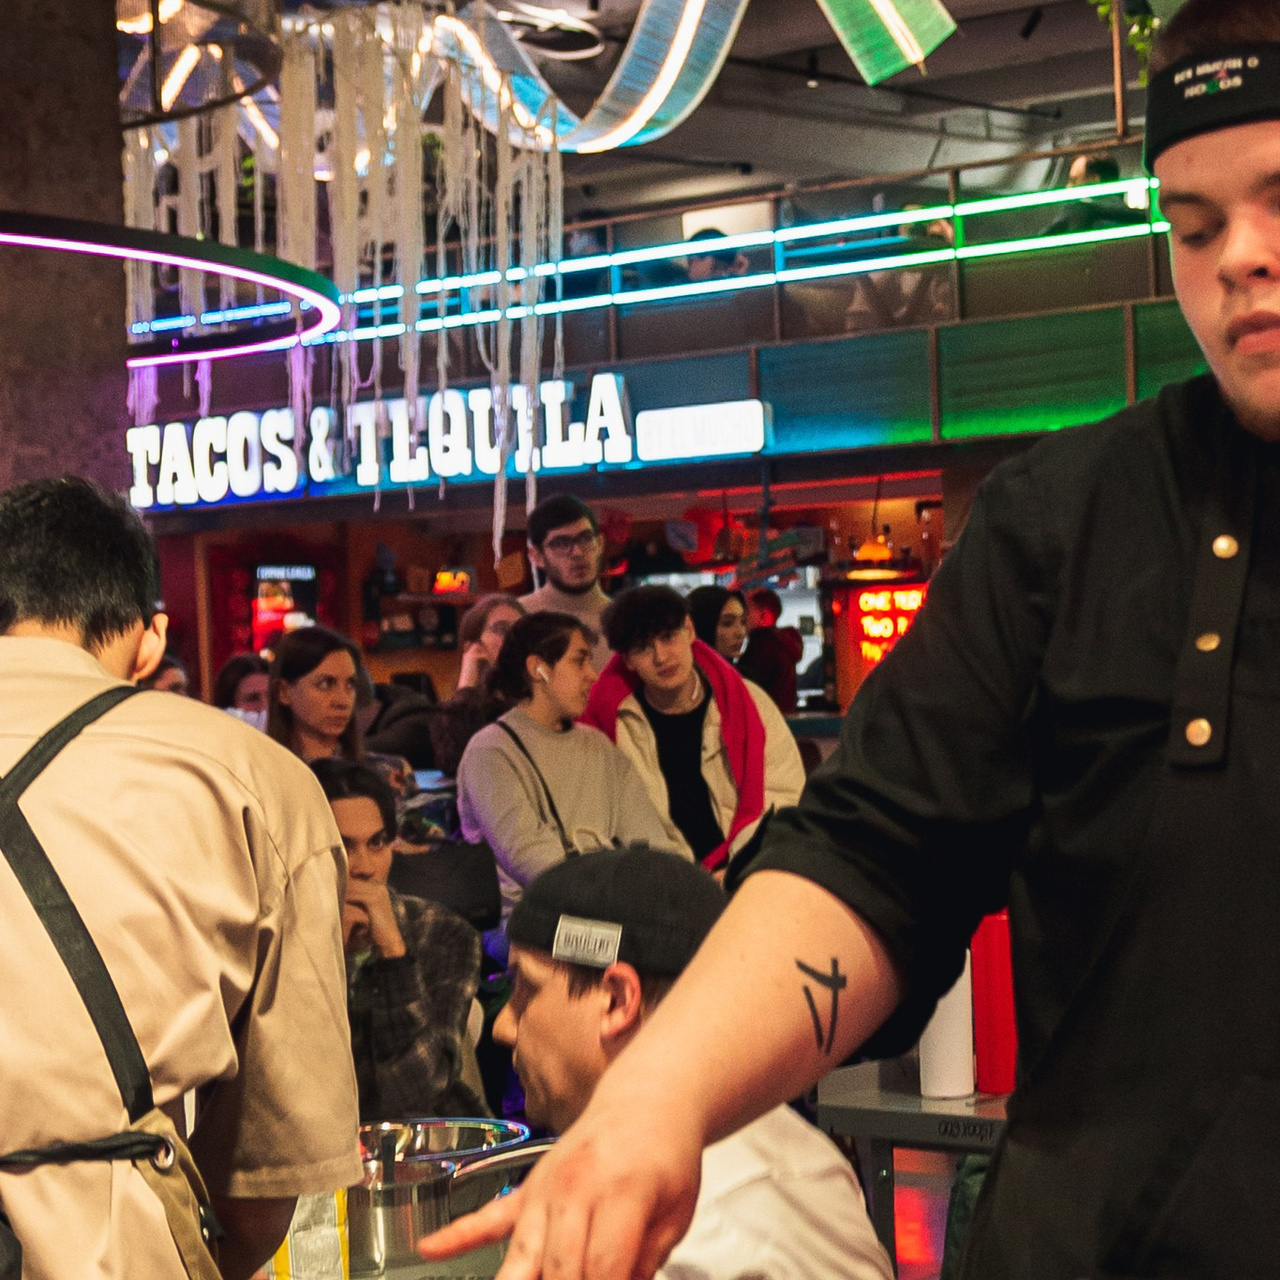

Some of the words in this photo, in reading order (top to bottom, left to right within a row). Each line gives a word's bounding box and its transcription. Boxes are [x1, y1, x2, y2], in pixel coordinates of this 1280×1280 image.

[127, 408, 298, 508] TACOS
[309, 408, 335, 483] &
[350, 373, 632, 486] TEQUILA
